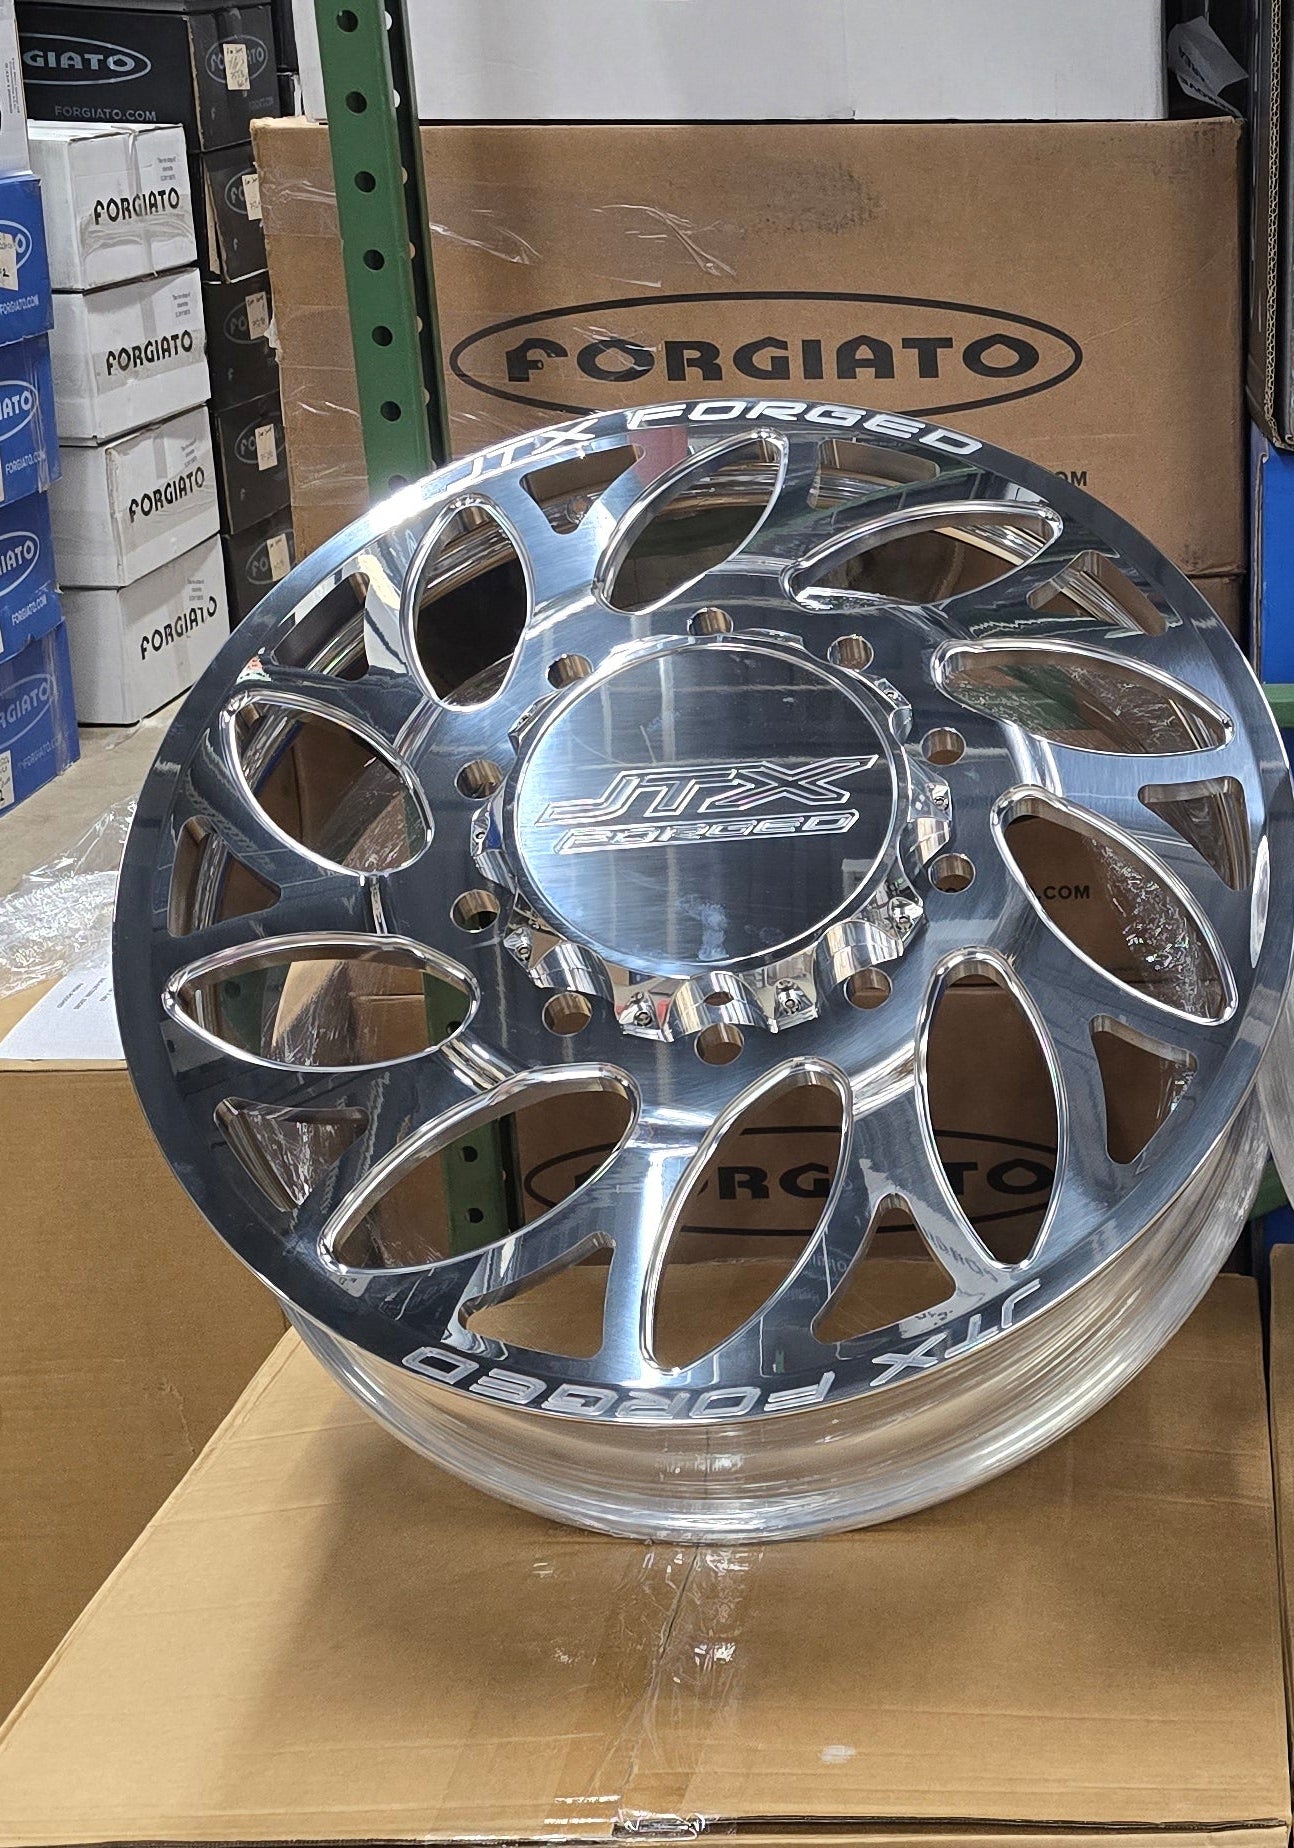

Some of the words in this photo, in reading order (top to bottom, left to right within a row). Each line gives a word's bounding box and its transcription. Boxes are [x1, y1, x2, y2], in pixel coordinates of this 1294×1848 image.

[54, 105, 157, 121] FORGIATO.COM
[93, 187, 180, 225] FORGIATO
[106, 329, 193, 376] FORGIATO
[505, 333, 1040, 383] FORGIATO
[626, 400, 984, 455] FORGED
[129, 466, 206, 524] FORGIATO
[140, 595, 218, 661] FORGIATO
[535, 753, 880, 827] JTX
[553, 809, 860, 856] FORGED
[1032, 885, 1090, 900] .COM
[869, 1278, 1042, 1387] JTX
[400, 1345, 837, 1421] FORGED
